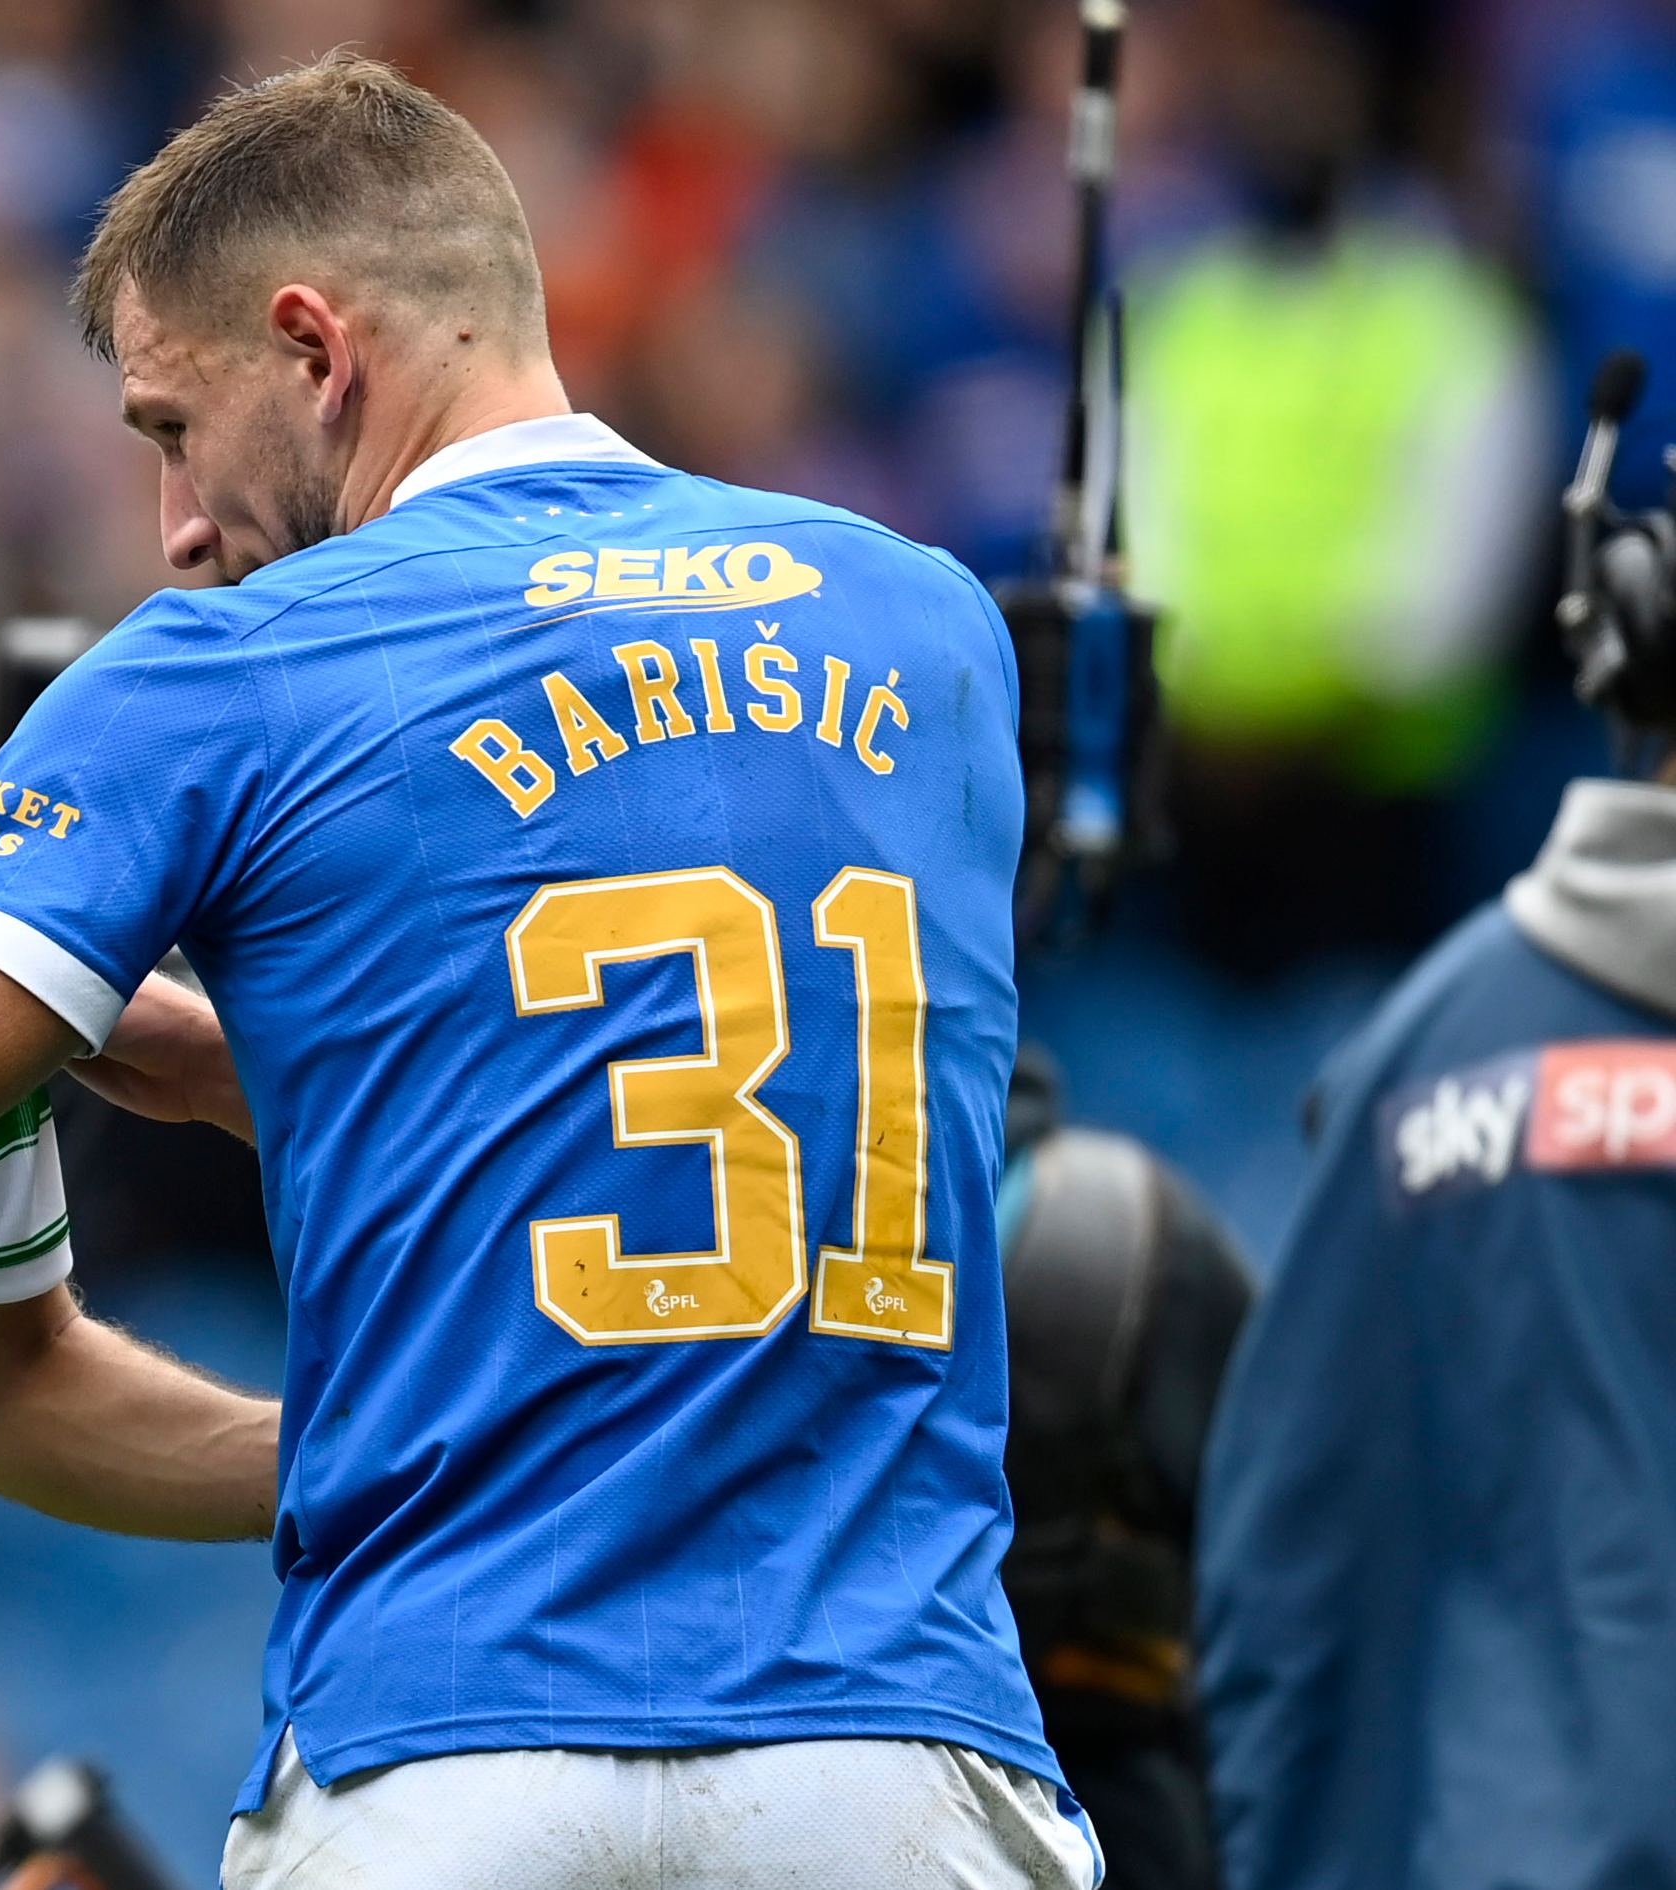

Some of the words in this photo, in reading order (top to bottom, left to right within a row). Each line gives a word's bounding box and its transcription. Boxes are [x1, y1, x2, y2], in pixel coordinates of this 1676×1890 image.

[524, 542, 822, 607] SEKO
[448, 620, 910, 820] BARIŠIĆ
[504, 865, 955, 1353] 31
[1396, 1072, 1530, 1197] sky
[660, 1294, 700, 1311] SPFL
[876, 1293, 909, 1313] SPFL
